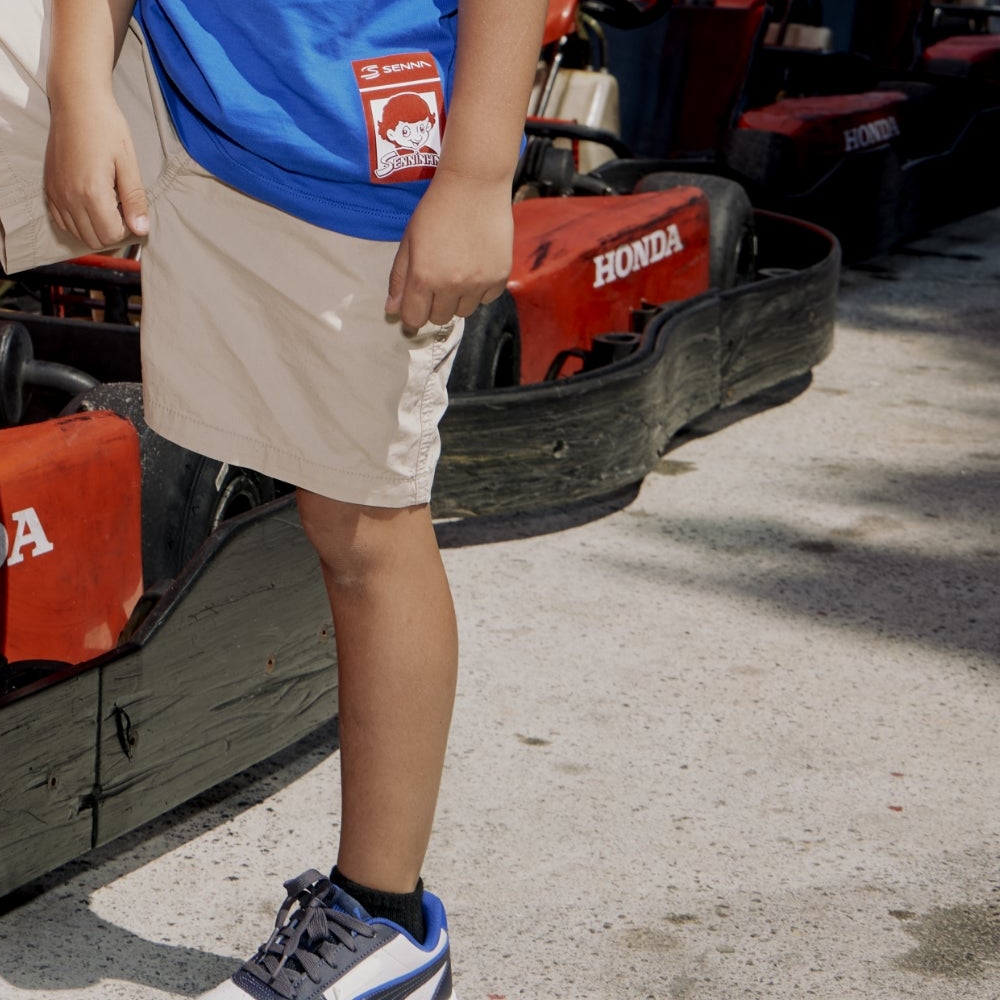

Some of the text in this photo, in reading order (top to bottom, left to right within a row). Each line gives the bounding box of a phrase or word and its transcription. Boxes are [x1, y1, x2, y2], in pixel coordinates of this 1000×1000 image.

[382, 60, 432, 74] SENNA
[843, 116, 901, 152] HONDA
[592, 223, 684, 288] HONDA
